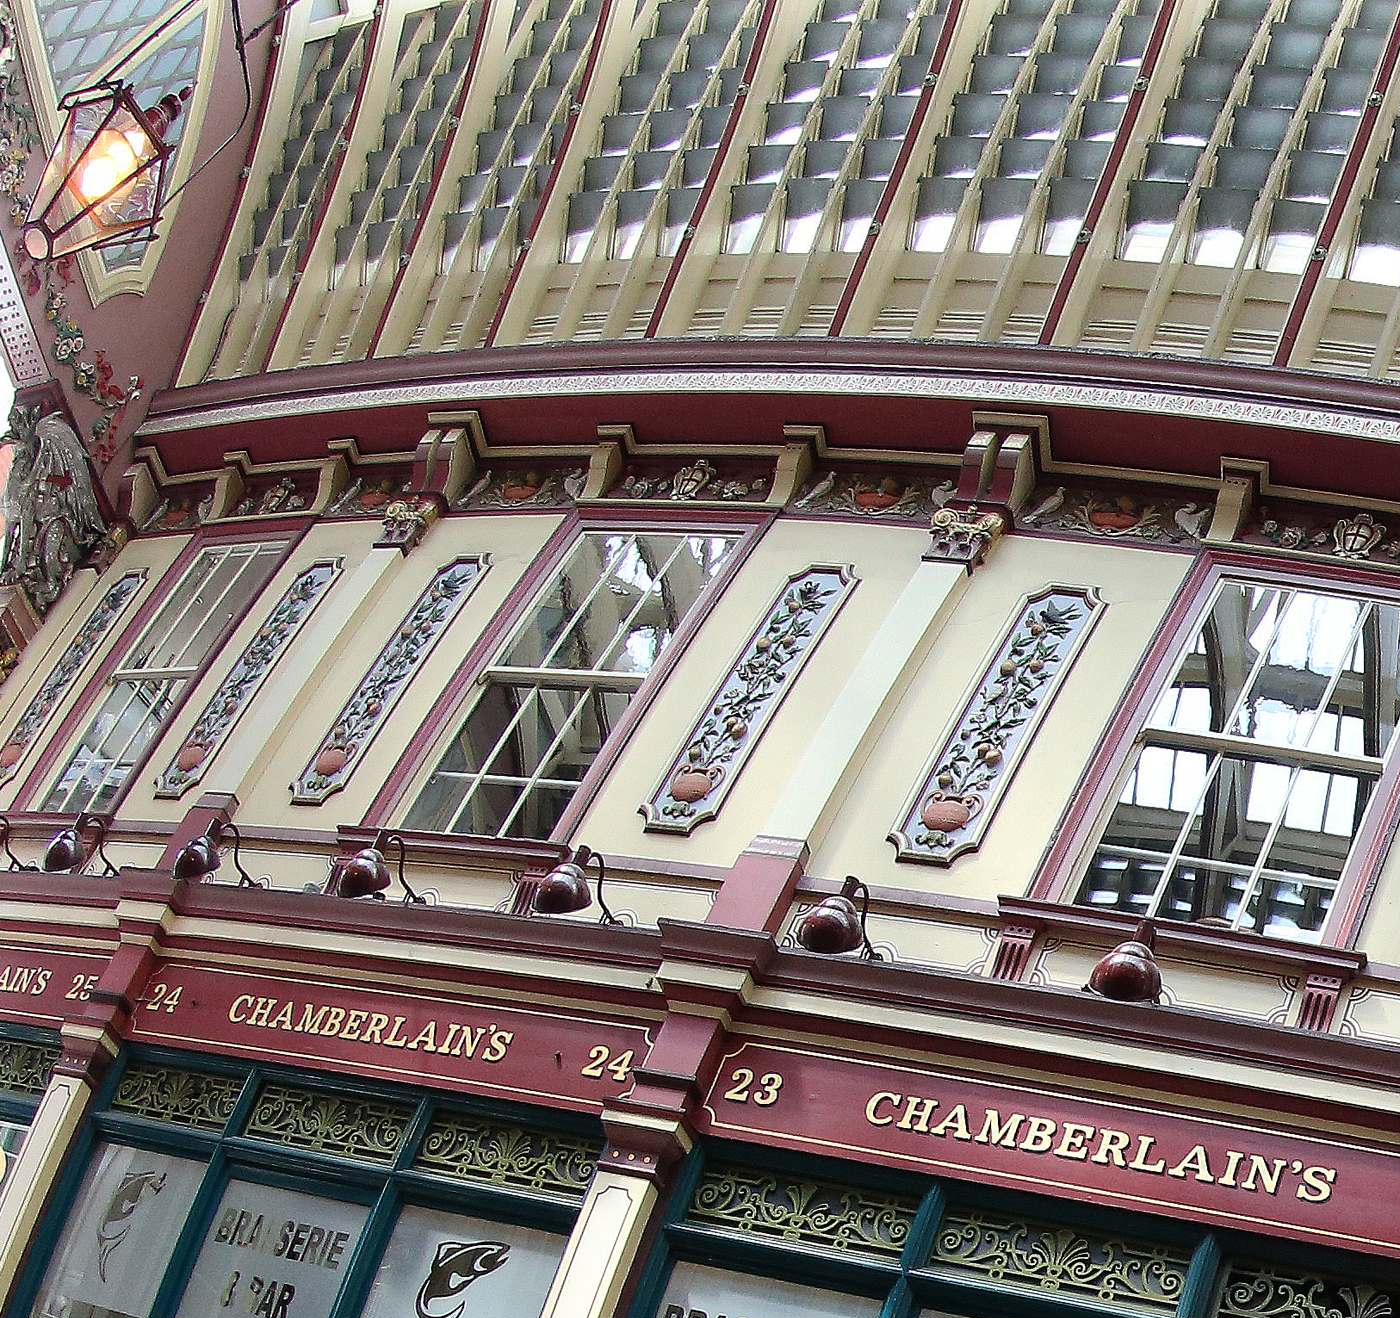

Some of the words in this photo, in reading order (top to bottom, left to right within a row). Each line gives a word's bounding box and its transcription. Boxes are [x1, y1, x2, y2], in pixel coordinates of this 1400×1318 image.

[64, 974, 100, 1001] 25
[146, 983, 184, 1013] 24
[228, 994, 514, 1062] CHAMBERLAIN'S
[581, 1044, 633, 1083] 24
[724, 1067, 784, 1106] 23
[866, 1091, 1338, 1203] CHAMBERLAIN'S
[212, 1206, 350, 1270] BRASERIE
